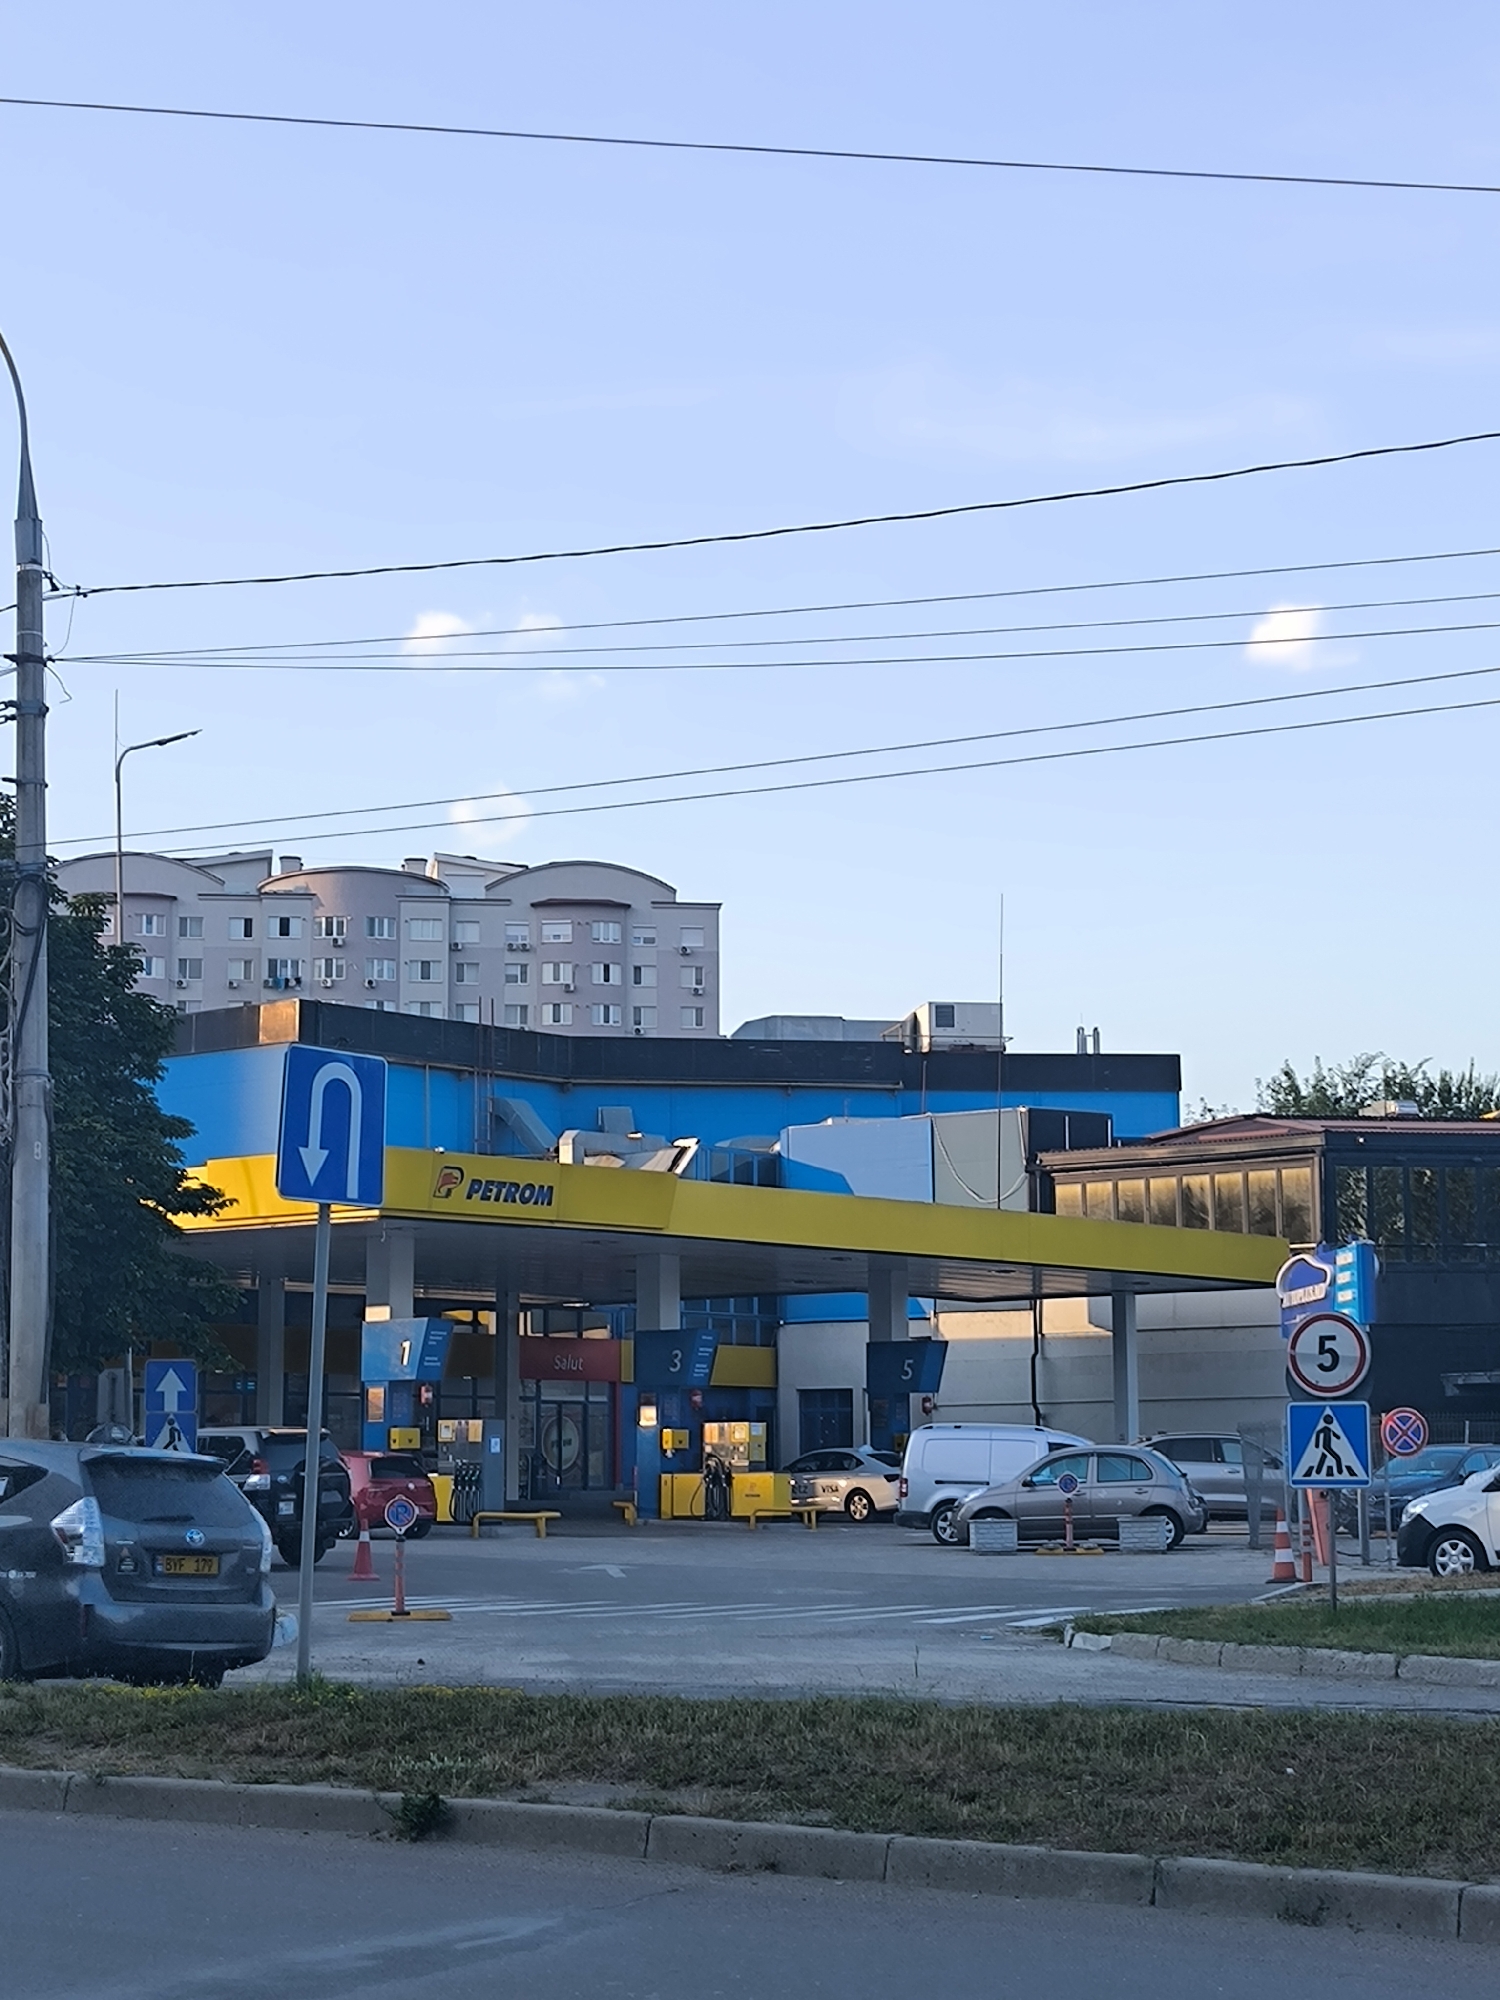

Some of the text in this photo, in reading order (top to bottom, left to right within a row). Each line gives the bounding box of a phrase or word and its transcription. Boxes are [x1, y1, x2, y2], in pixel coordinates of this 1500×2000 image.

[465, 1178, 554, 1206] PETROM
[400, 1339, 412, 1366] 1
[554, 1354, 584, 1371] Salut
[669, 1350, 682, 1373] 3
[1317, 1335, 1340, 1373] 5
[901, 1359, 914, 1380] 5
